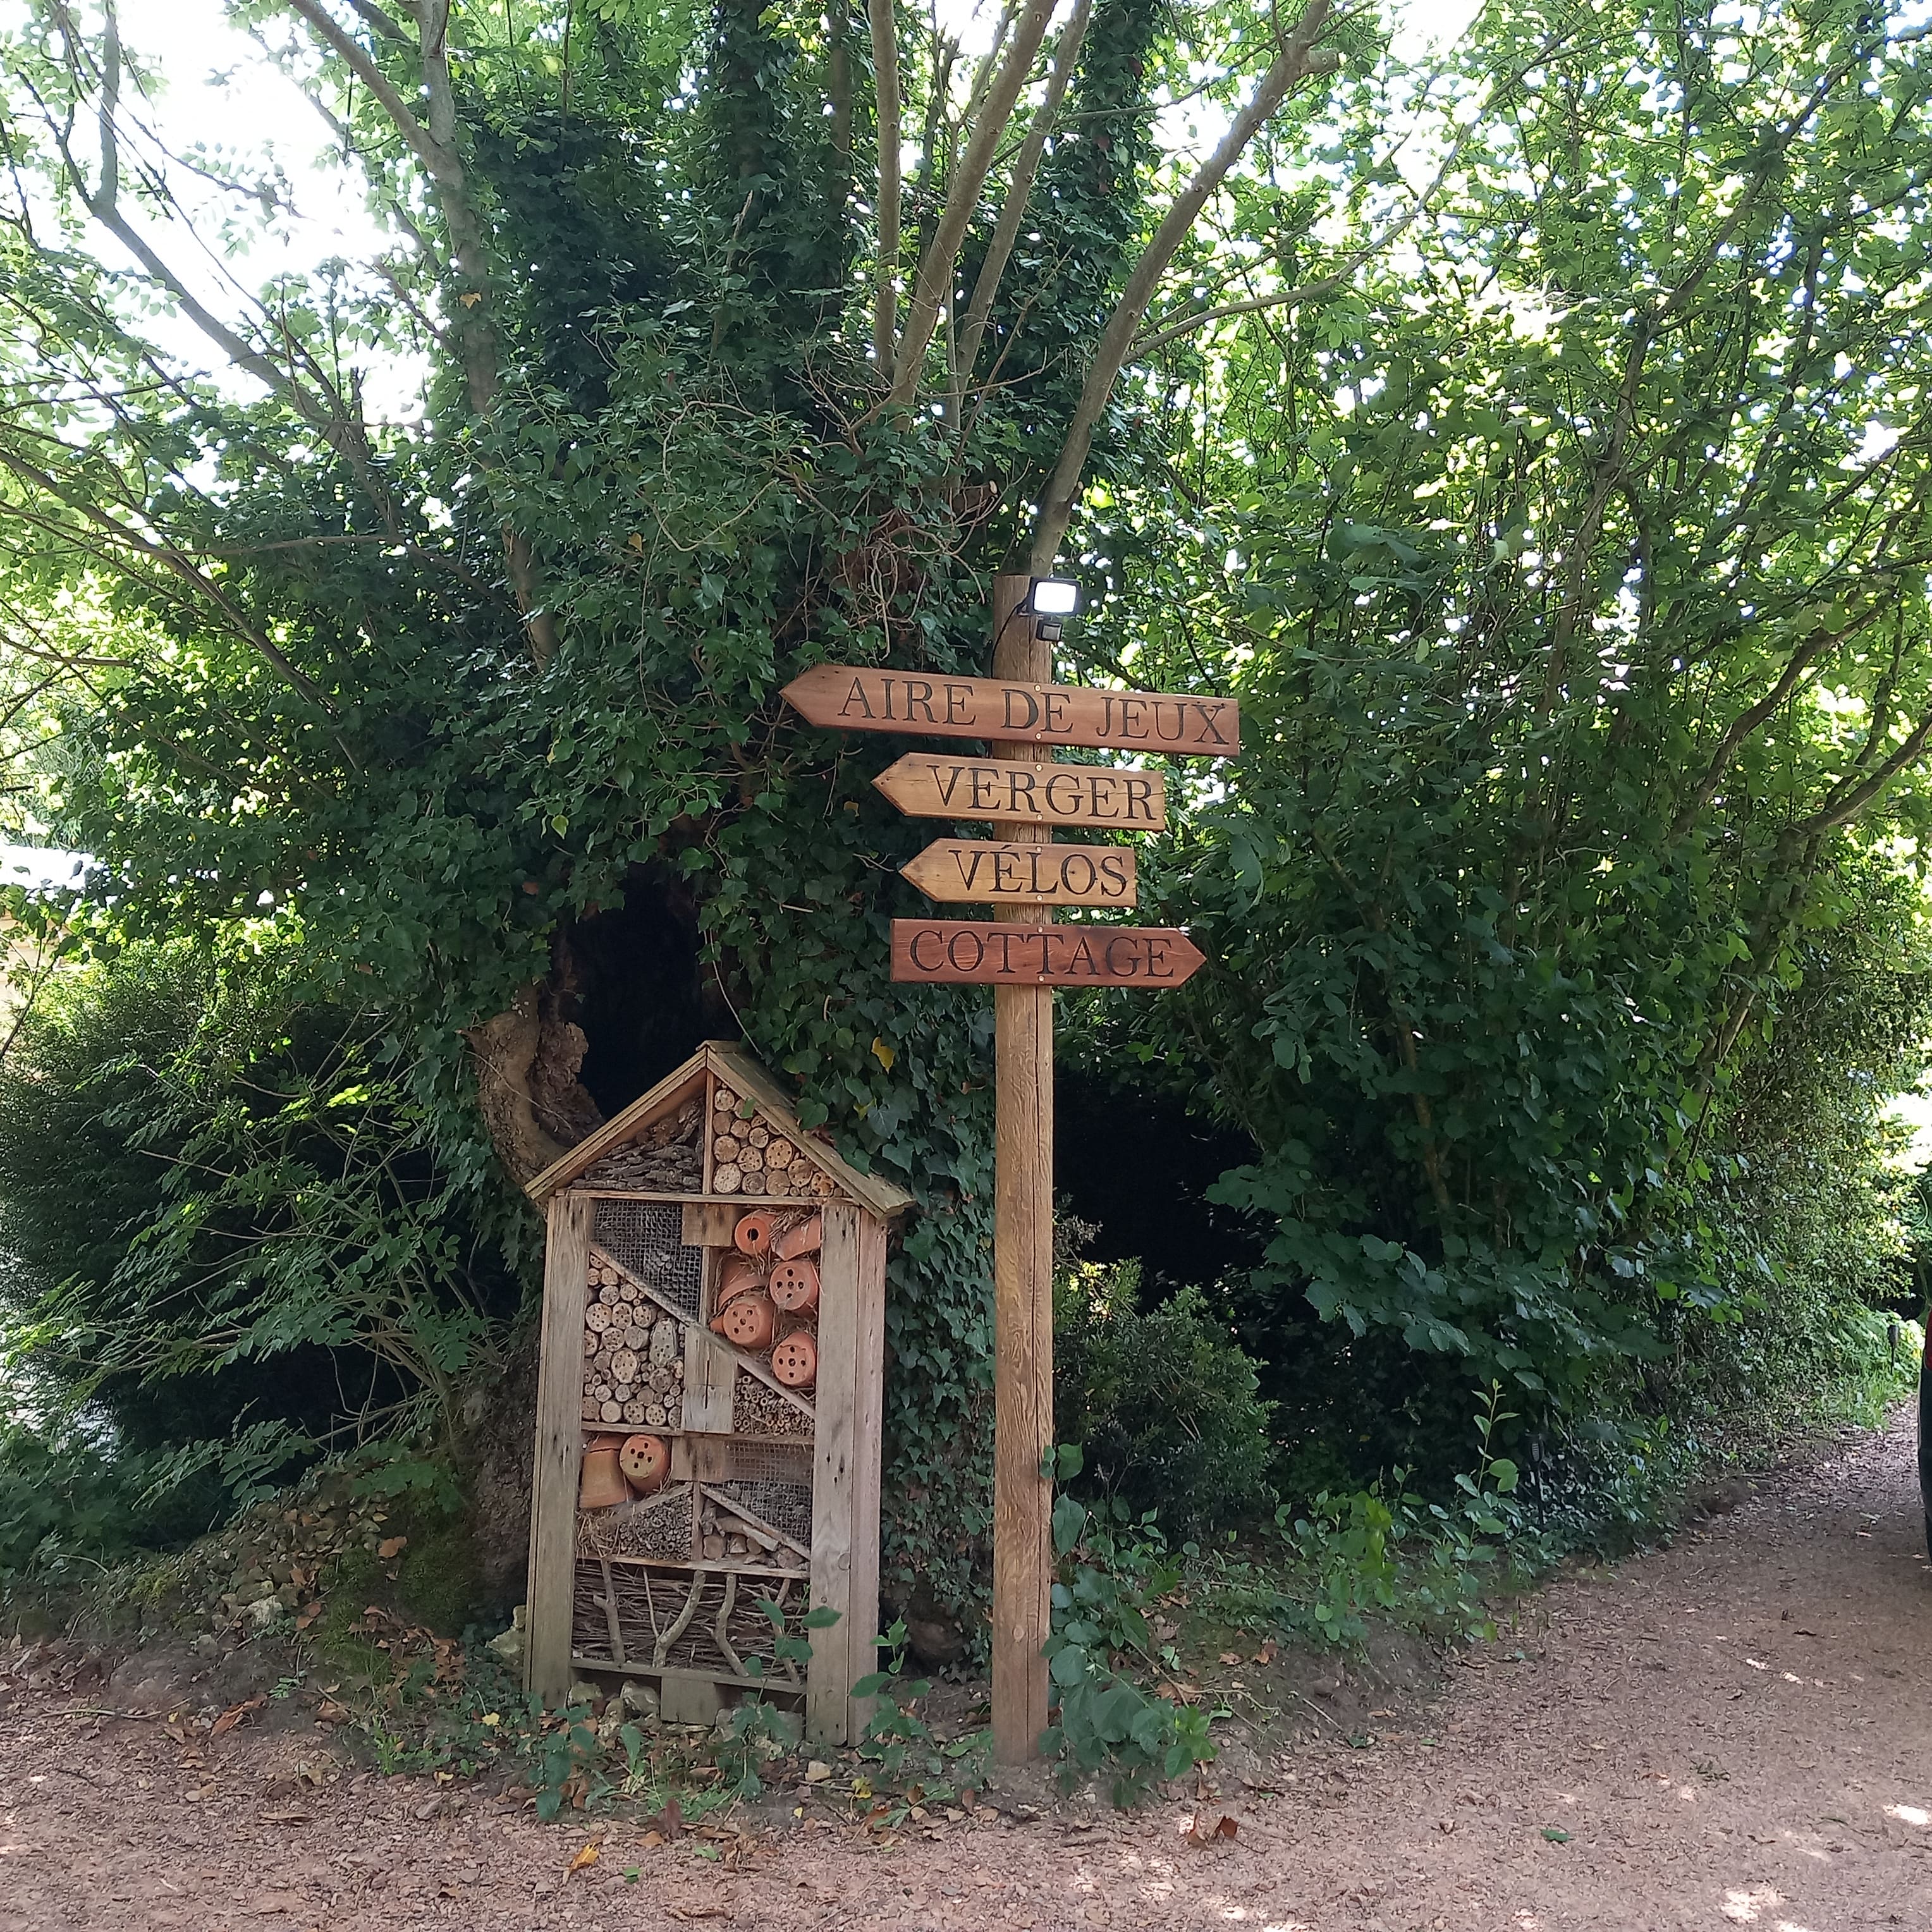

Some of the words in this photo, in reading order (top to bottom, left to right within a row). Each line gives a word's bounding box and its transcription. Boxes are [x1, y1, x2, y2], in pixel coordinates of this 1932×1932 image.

[838, 676, 977, 726] AIRE
[1001, 688, 1074, 733] DE
[1096, 697, 1230, 745] JEUX
[926, 764, 1158, 821] VERGER
[948, 846, 1128, 896] VÉLOS
[910, 930, 1175, 978] COTTAGE
